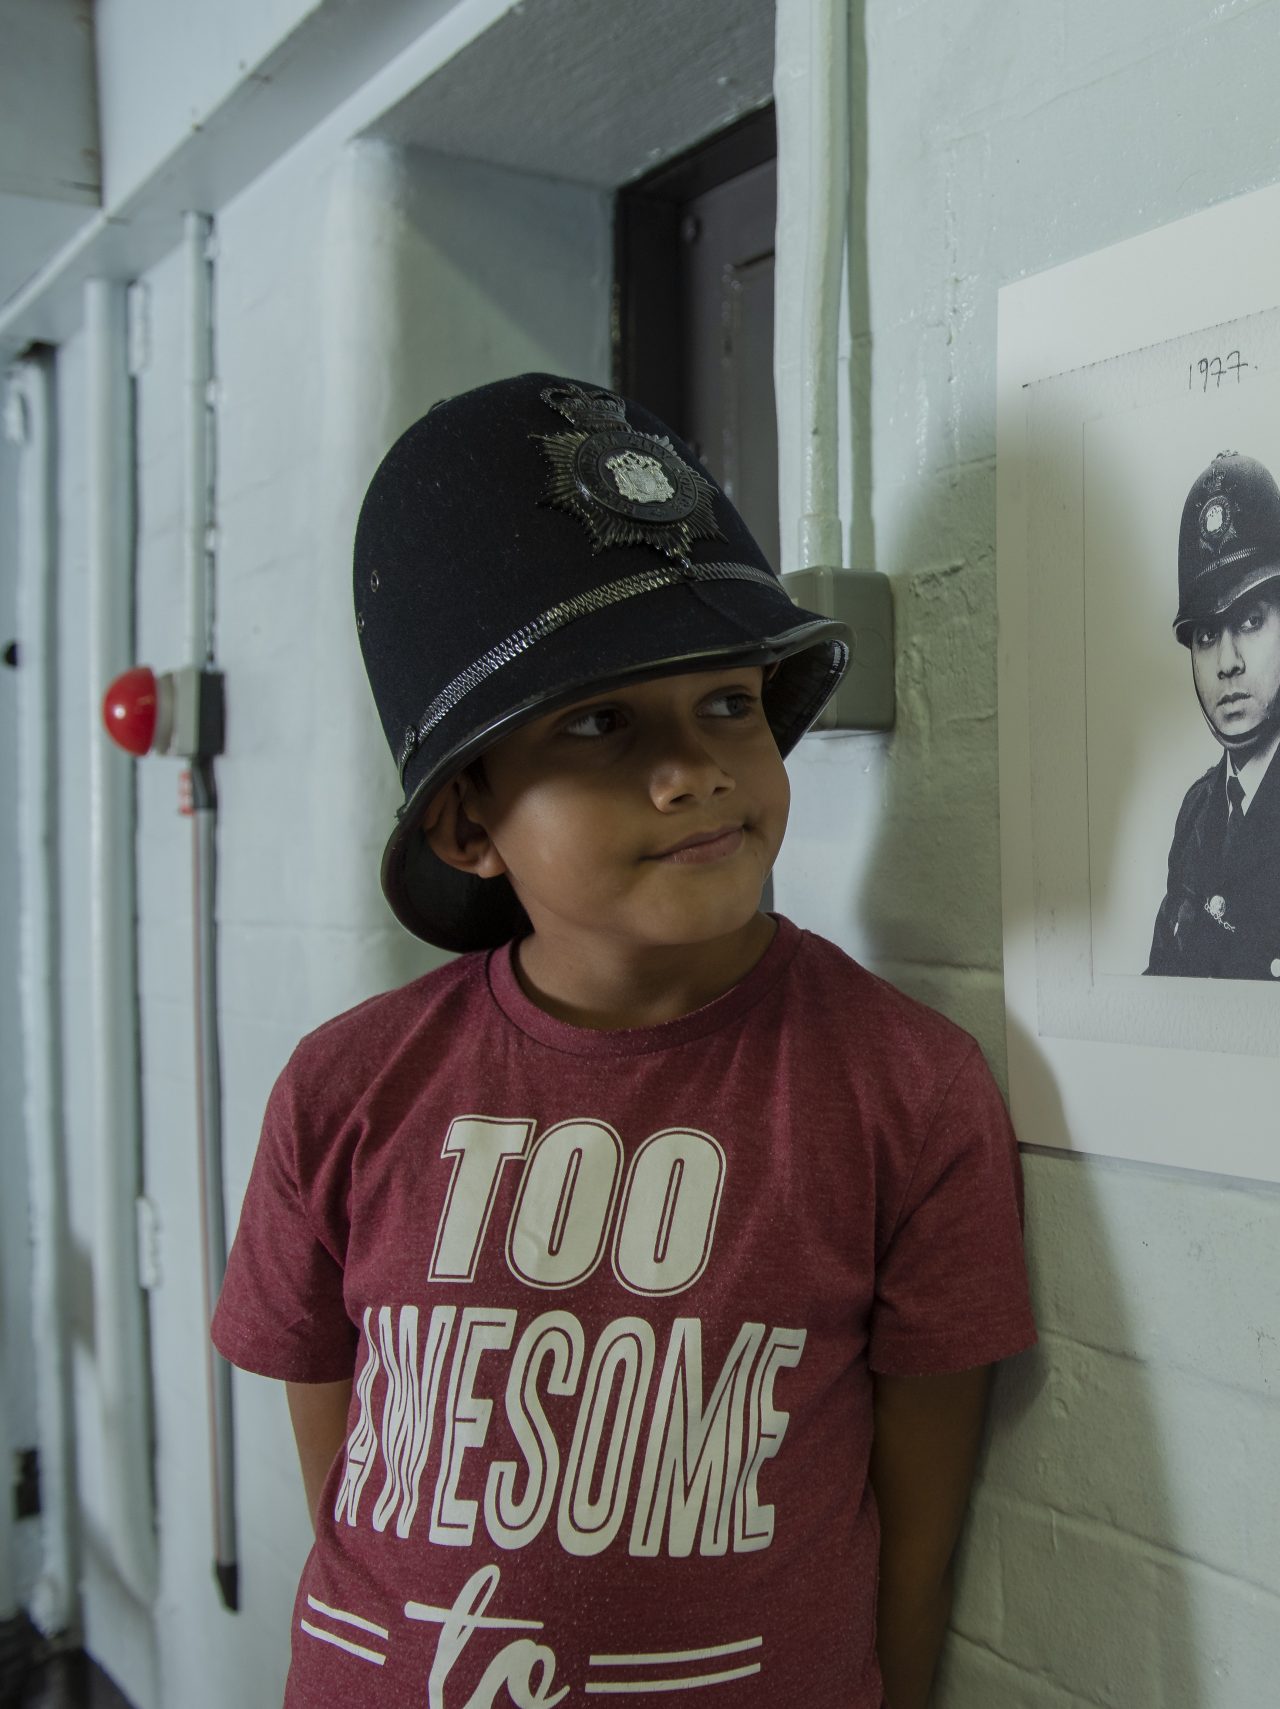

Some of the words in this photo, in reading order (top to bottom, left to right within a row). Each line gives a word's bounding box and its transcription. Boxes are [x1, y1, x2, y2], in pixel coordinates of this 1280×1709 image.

[427, 1114, 727, 1297] TOO
[334, 1305, 807, 1558] AWESOME
[403, 1564, 571, 1709] to
